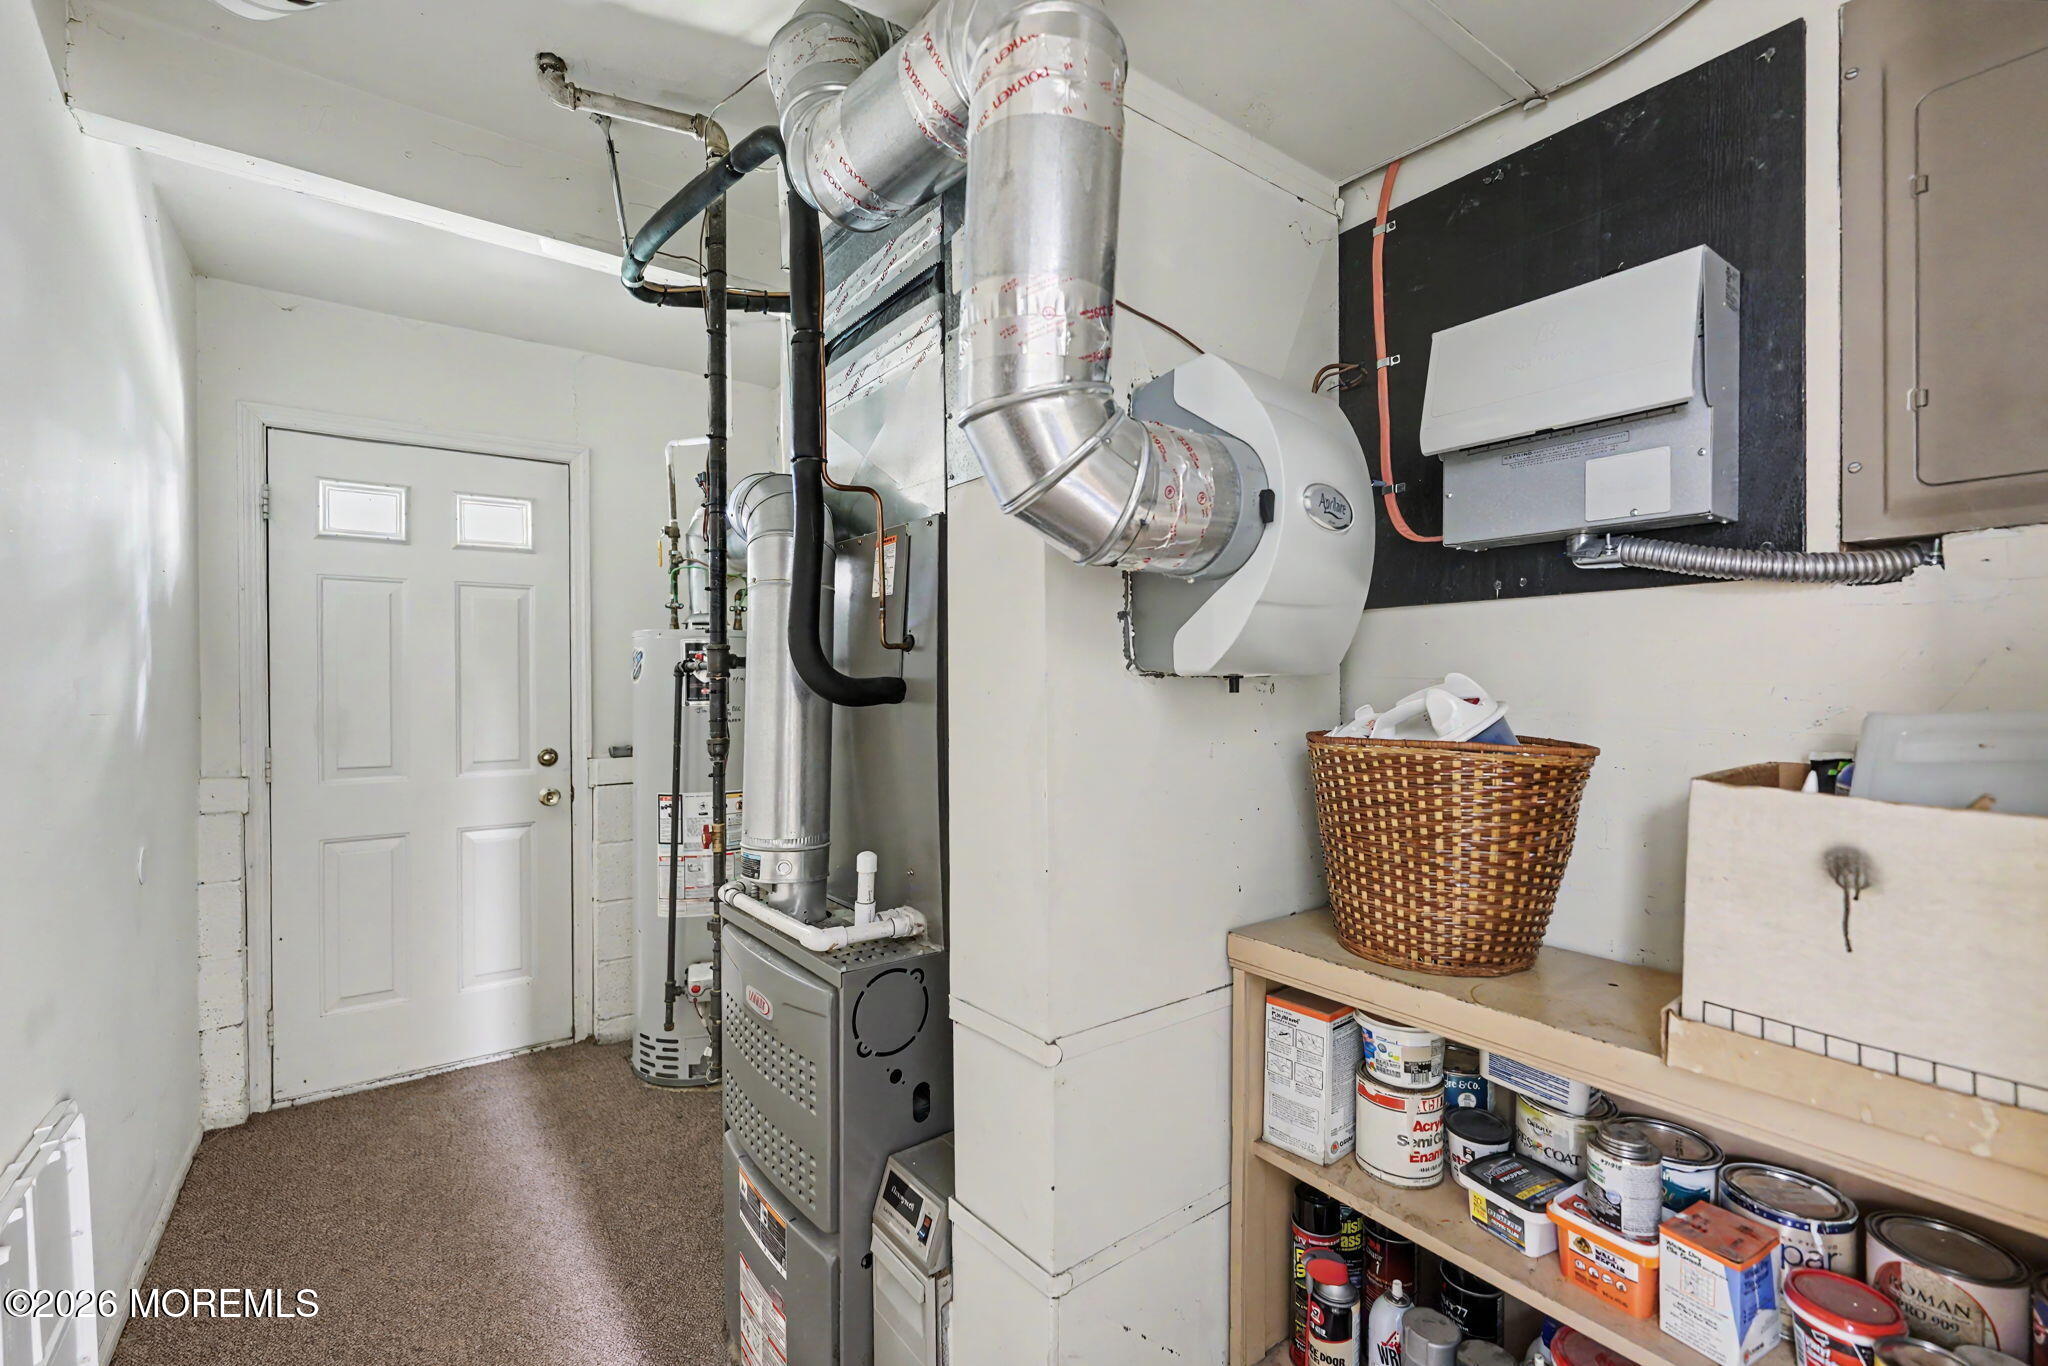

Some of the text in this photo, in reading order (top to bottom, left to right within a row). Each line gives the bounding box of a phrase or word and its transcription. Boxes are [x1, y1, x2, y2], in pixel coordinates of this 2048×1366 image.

[1543, 1146, 1583, 1167] COAT
[1340, 1233, 1361, 1248] ass
[1781, 1243, 1836, 1271] par
[1888, 1274, 1971, 1320] ROMAN
